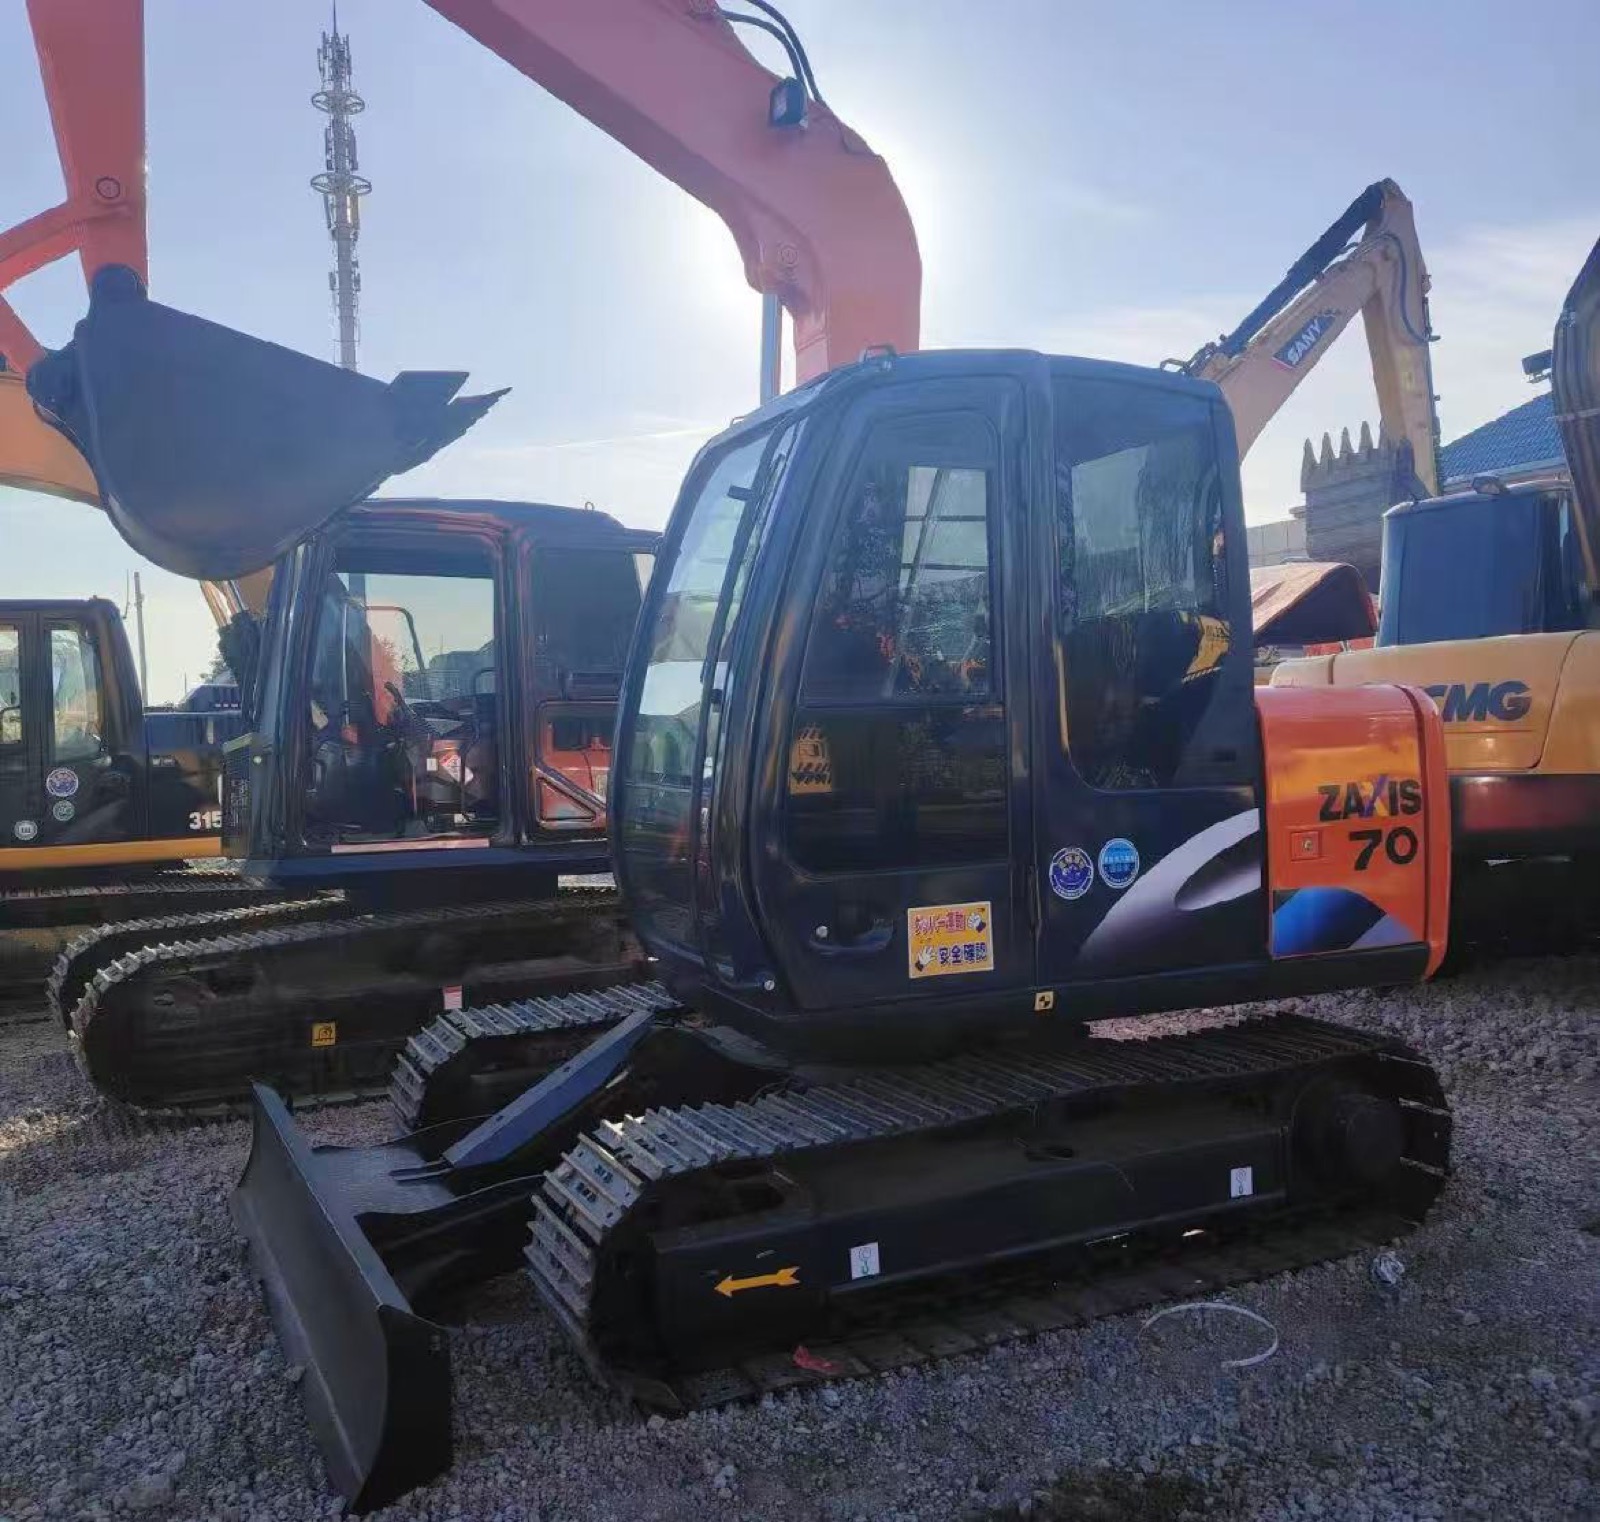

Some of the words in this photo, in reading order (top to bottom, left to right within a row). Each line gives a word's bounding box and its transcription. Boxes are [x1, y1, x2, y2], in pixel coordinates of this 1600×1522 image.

[1287, 319, 1320, 365] SANY
[189, 810, 222, 829] 315
[1317, 774, 1422, 821] ZAXIS
[1348, 826, 1418, 871] 70
